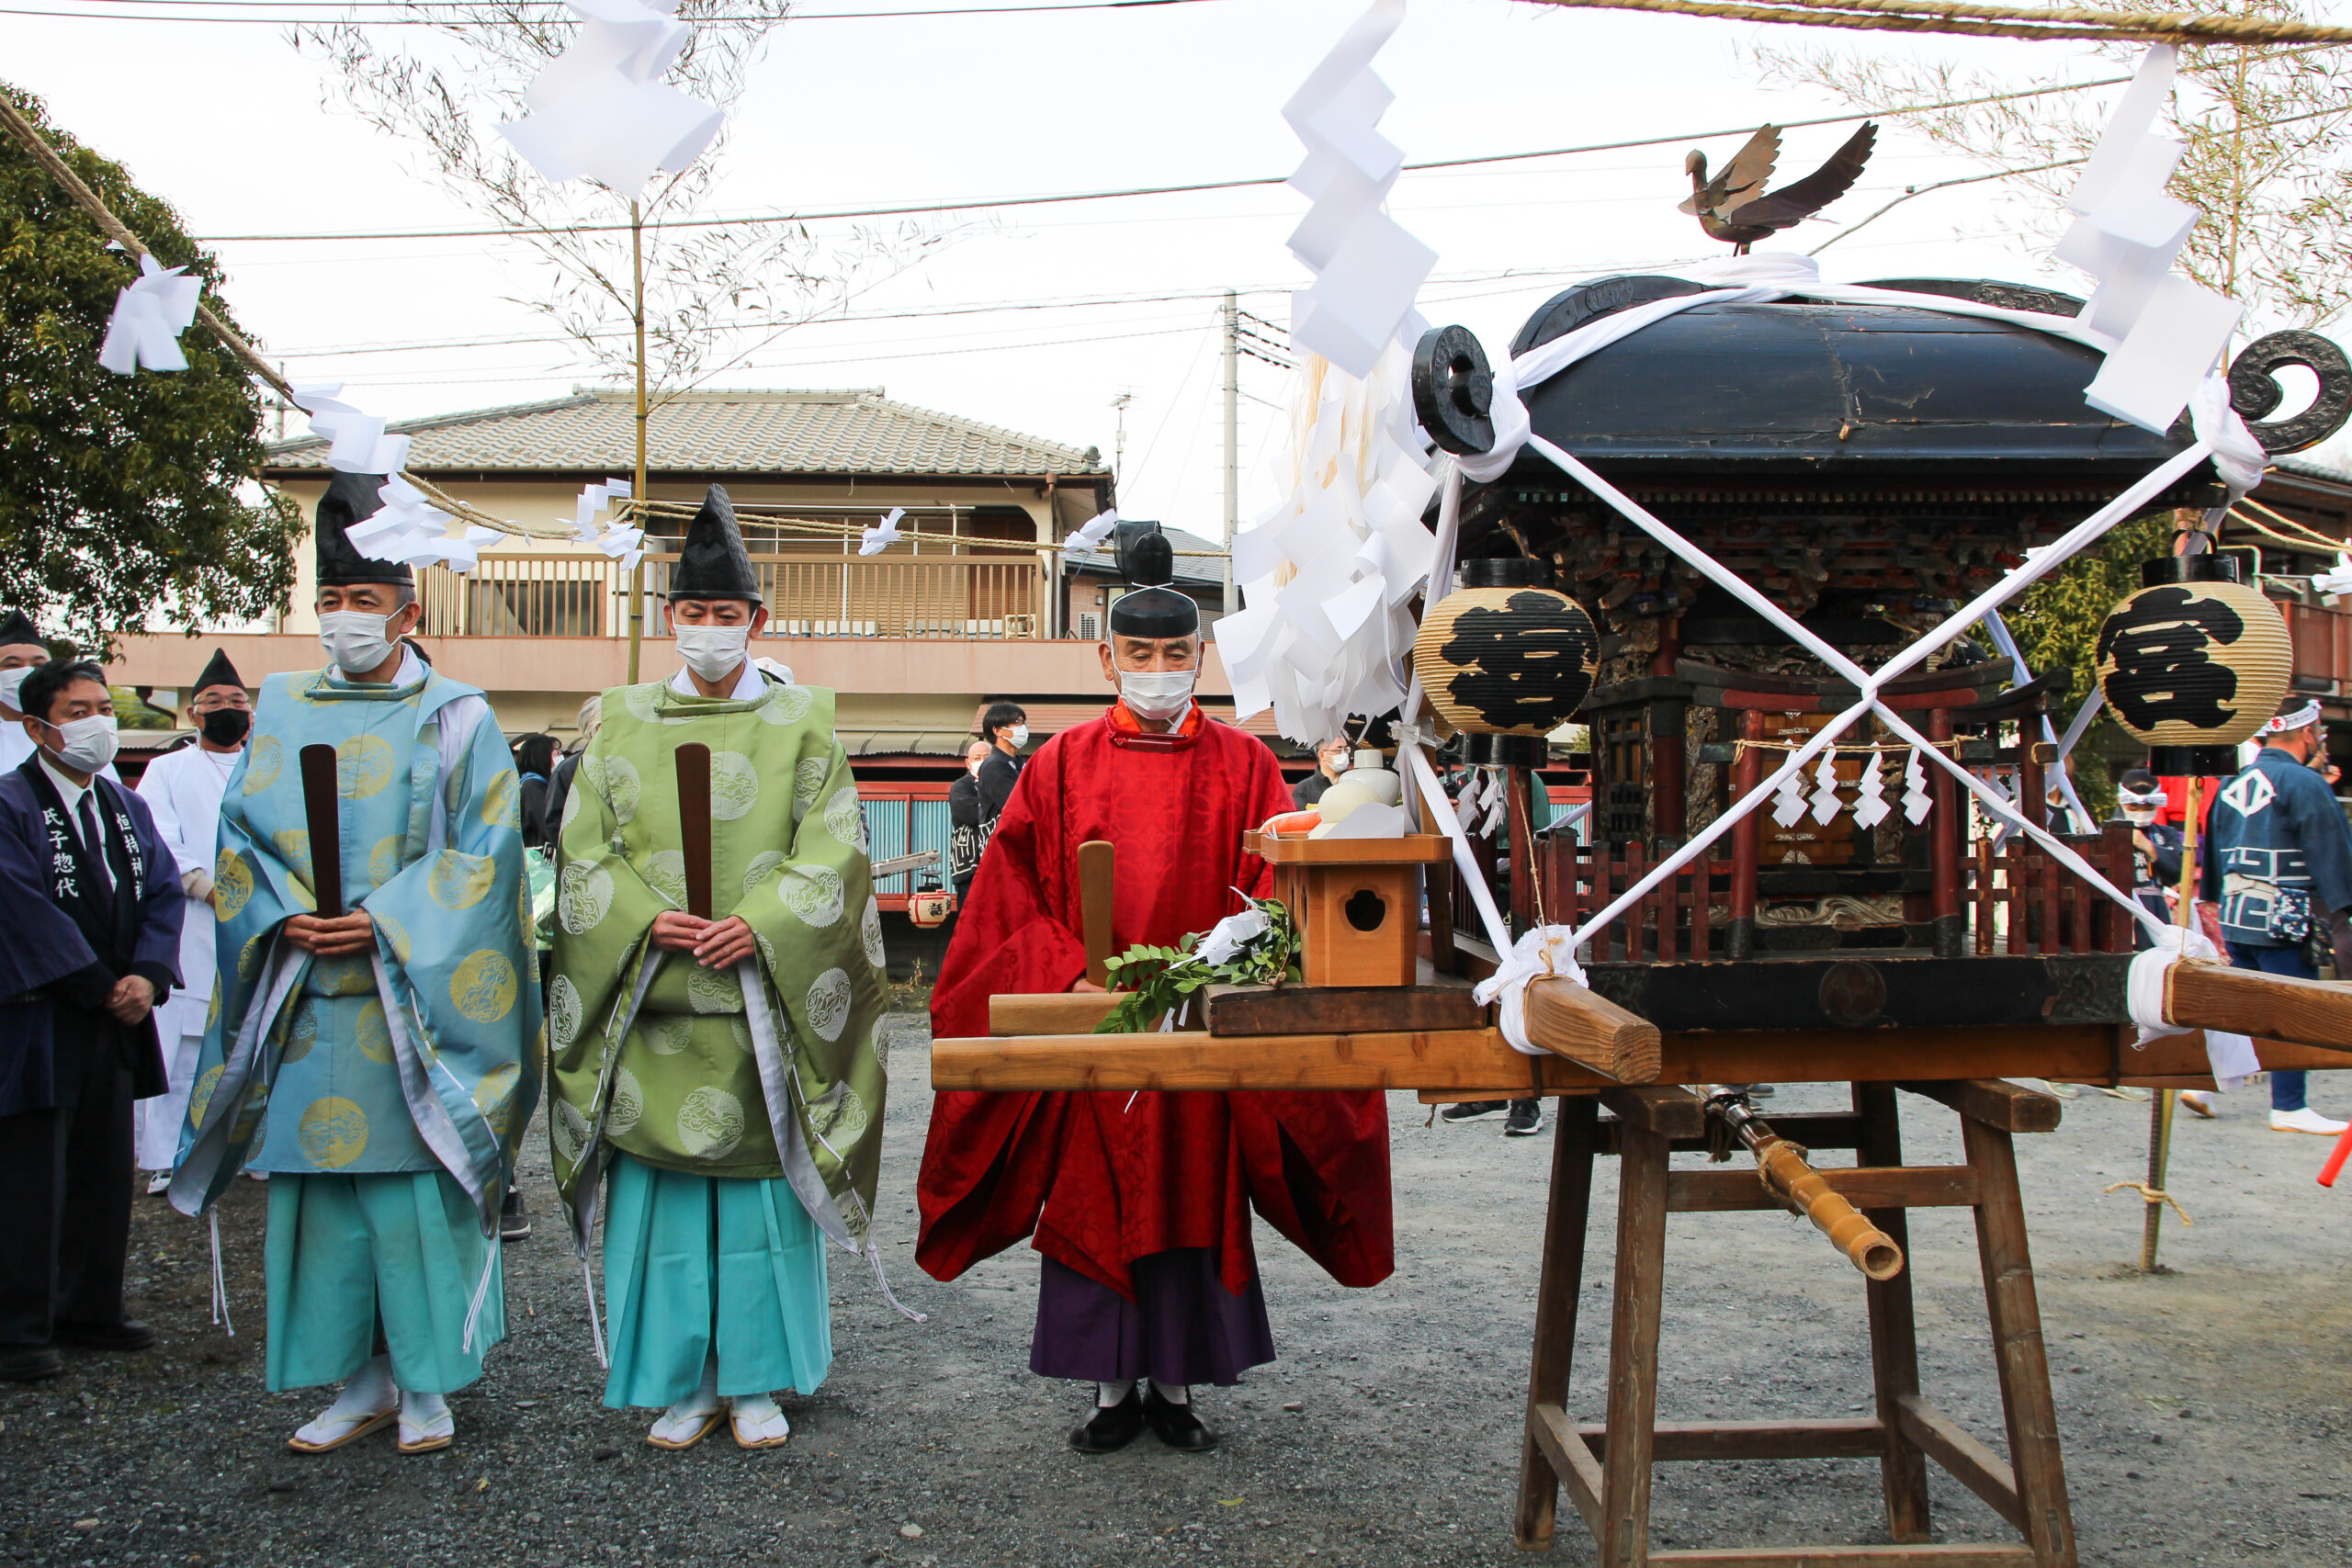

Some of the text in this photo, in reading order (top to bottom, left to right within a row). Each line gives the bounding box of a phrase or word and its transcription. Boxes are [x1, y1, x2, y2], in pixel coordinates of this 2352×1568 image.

[2097, 587, 2245, 731] 宮
[42, 807, 79, 898] 氏子惣代
